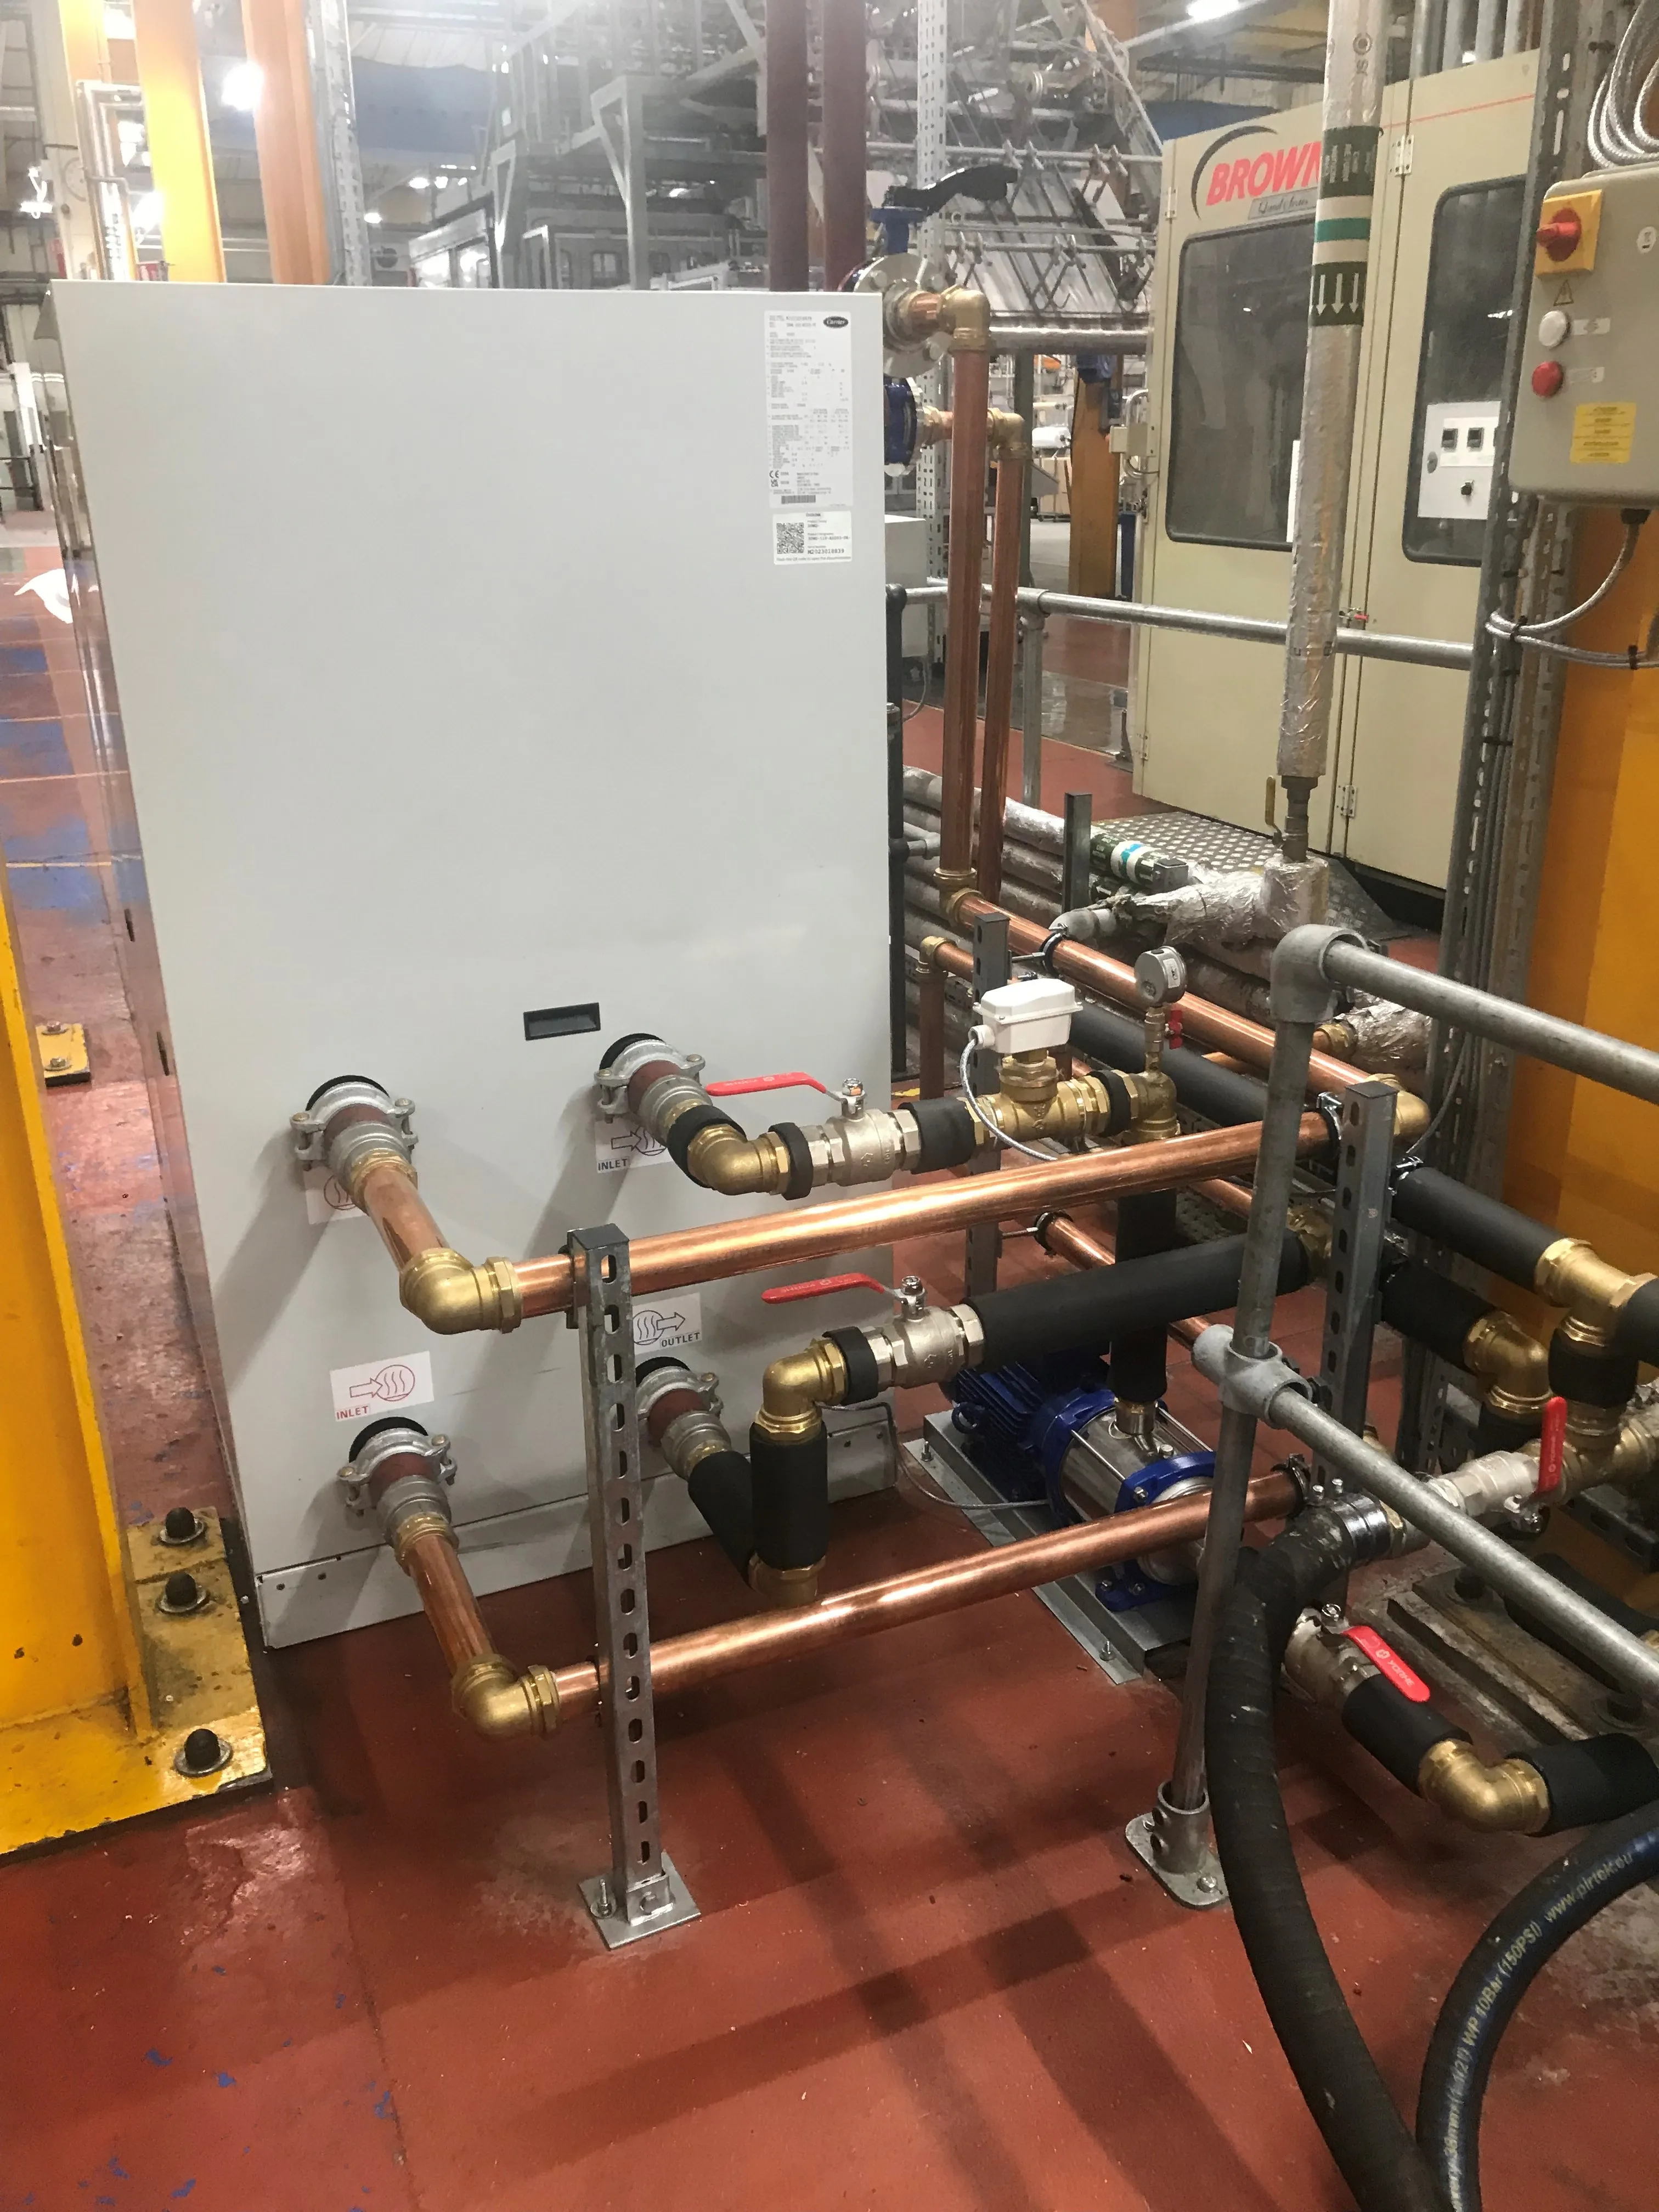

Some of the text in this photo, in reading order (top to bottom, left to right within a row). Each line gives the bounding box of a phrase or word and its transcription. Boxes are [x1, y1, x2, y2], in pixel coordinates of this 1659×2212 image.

[598, 1158, 628, 1171] INLET
[661, 1331, 700, 1347] OUTLET
[336, 1406, 368, 1419] INLET
[1462, 2016, 1480, 2047] WP
[1475, 1974, 1503, 2017] 10Bar
[1497, 1920, 1543, 1978] (150PSI)
